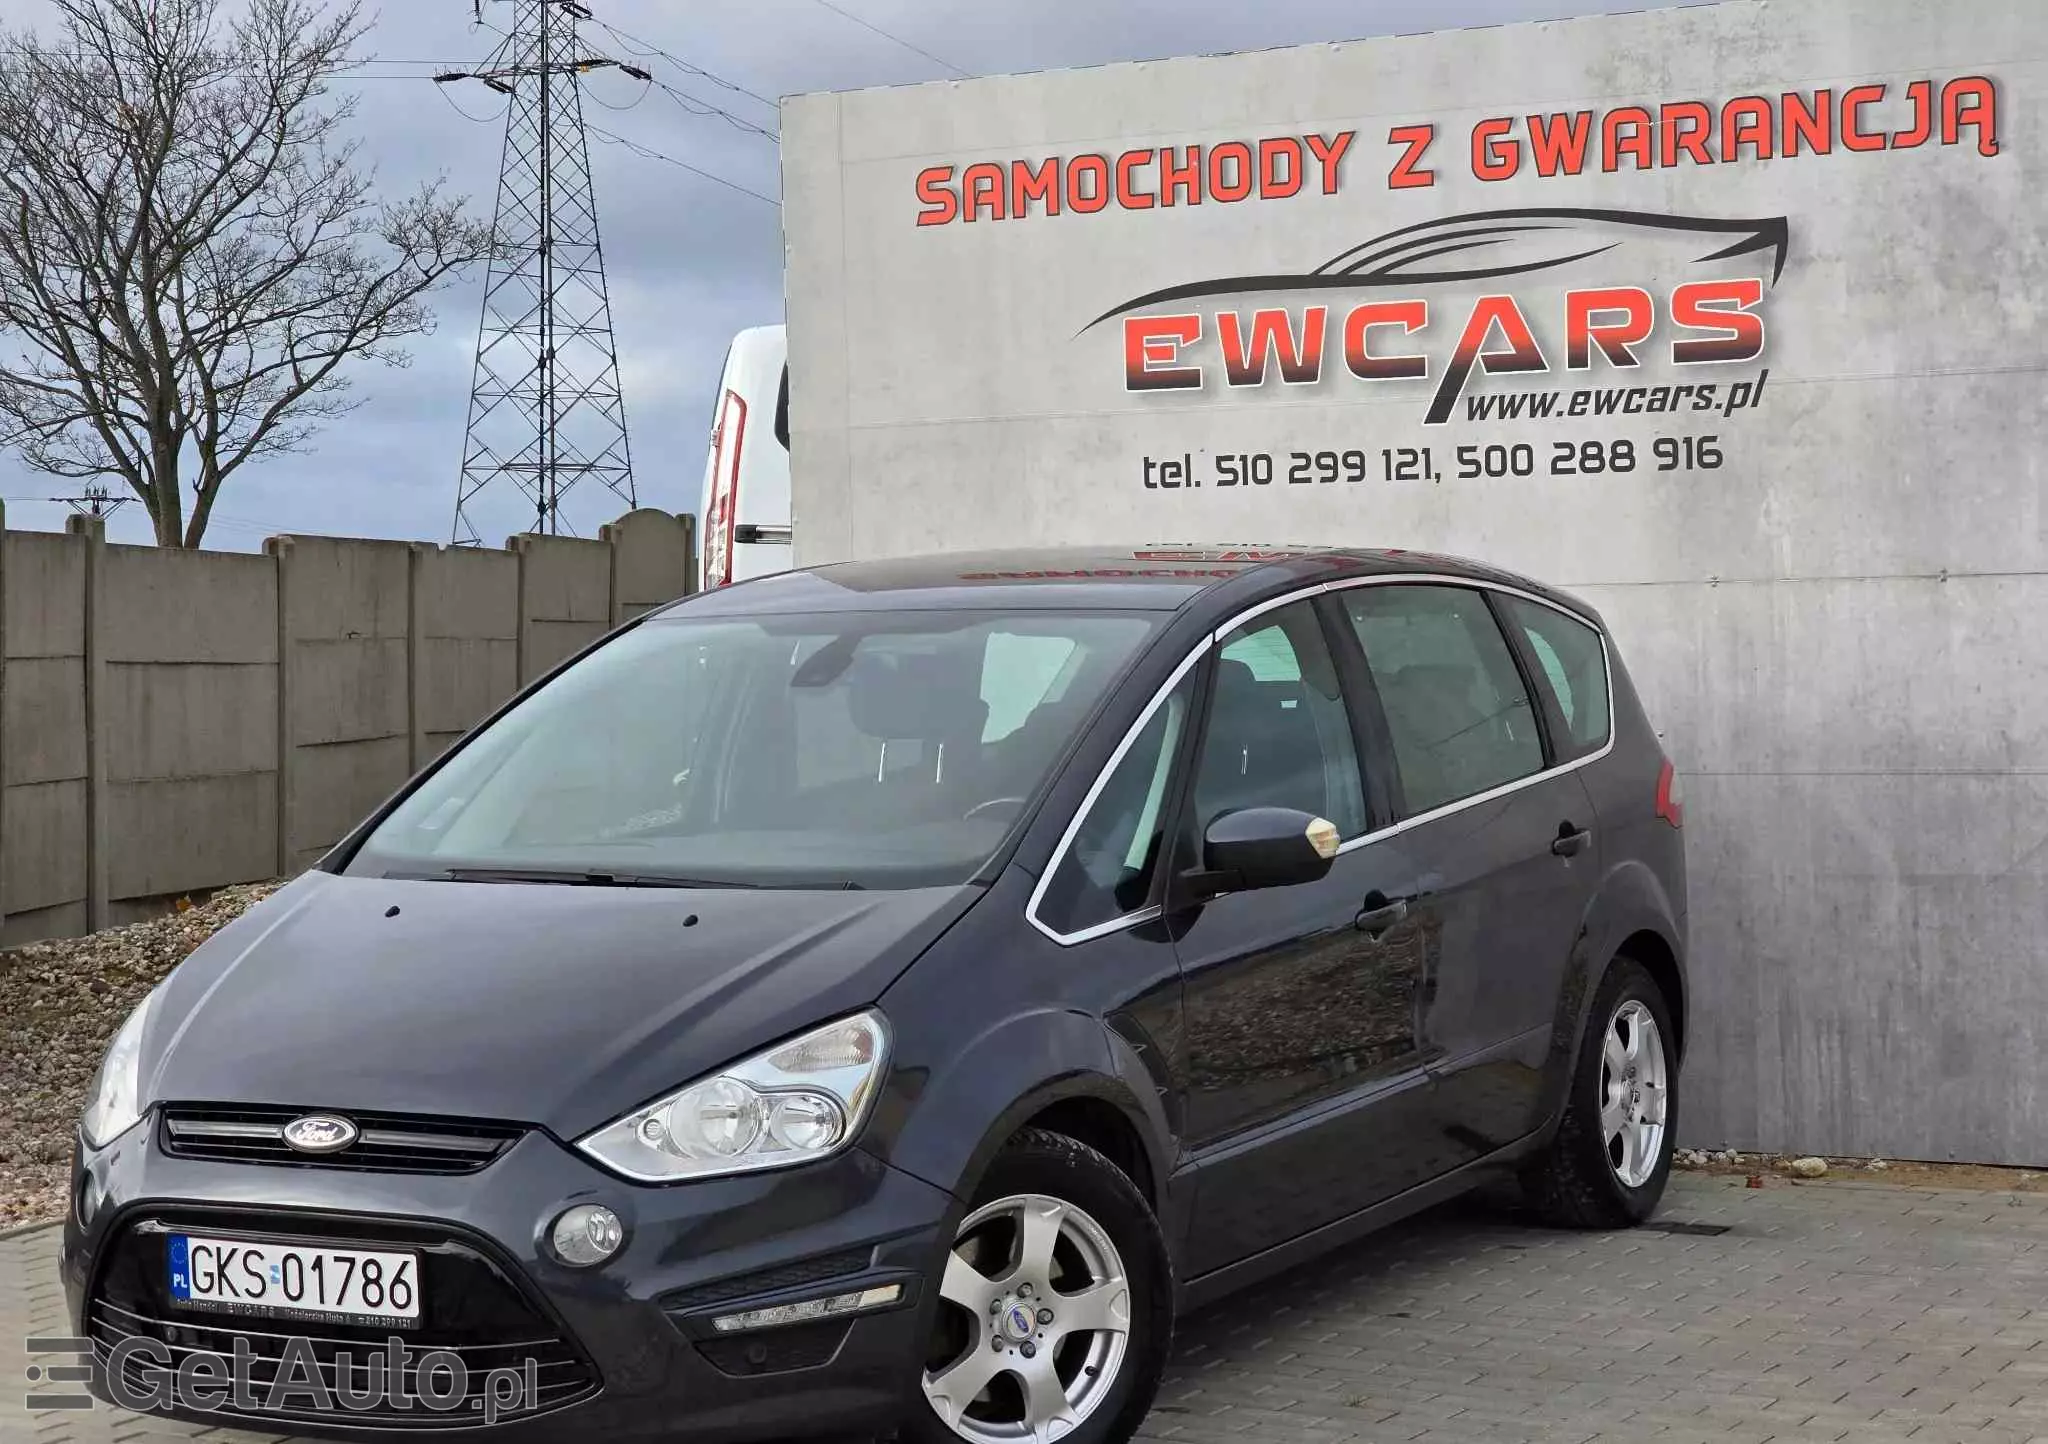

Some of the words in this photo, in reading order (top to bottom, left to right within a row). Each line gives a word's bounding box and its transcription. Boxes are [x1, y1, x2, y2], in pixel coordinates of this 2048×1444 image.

[916, 131, 1356, 226] SAMOCHODY
[1388, 124, 1435, 189] Z
[1471, 75, 2000, 181] GWARANCJĄ
[1122, 277, 1766, 425] EWCARS
[1466, 369, 1768, 421] www.ewcars.pl
[1144, 453, 1200, 488] tel.
[1215, 454, 1272, 486] 510
[1289, 450, 1366, 483] 299
[1381, 448, 1441, 483] 121,
[1456, 443, 1533, 479] 500
[1550, 439, 1636, 475] 288
[1652, 435, 1724, 471] 916
[295, 1121, 339, 1142] Ford
[173, 1273, 187, 1288] PL
[191, 1245, 267, 1298] GKS
[281, 1252, 412, 1310] 01786
